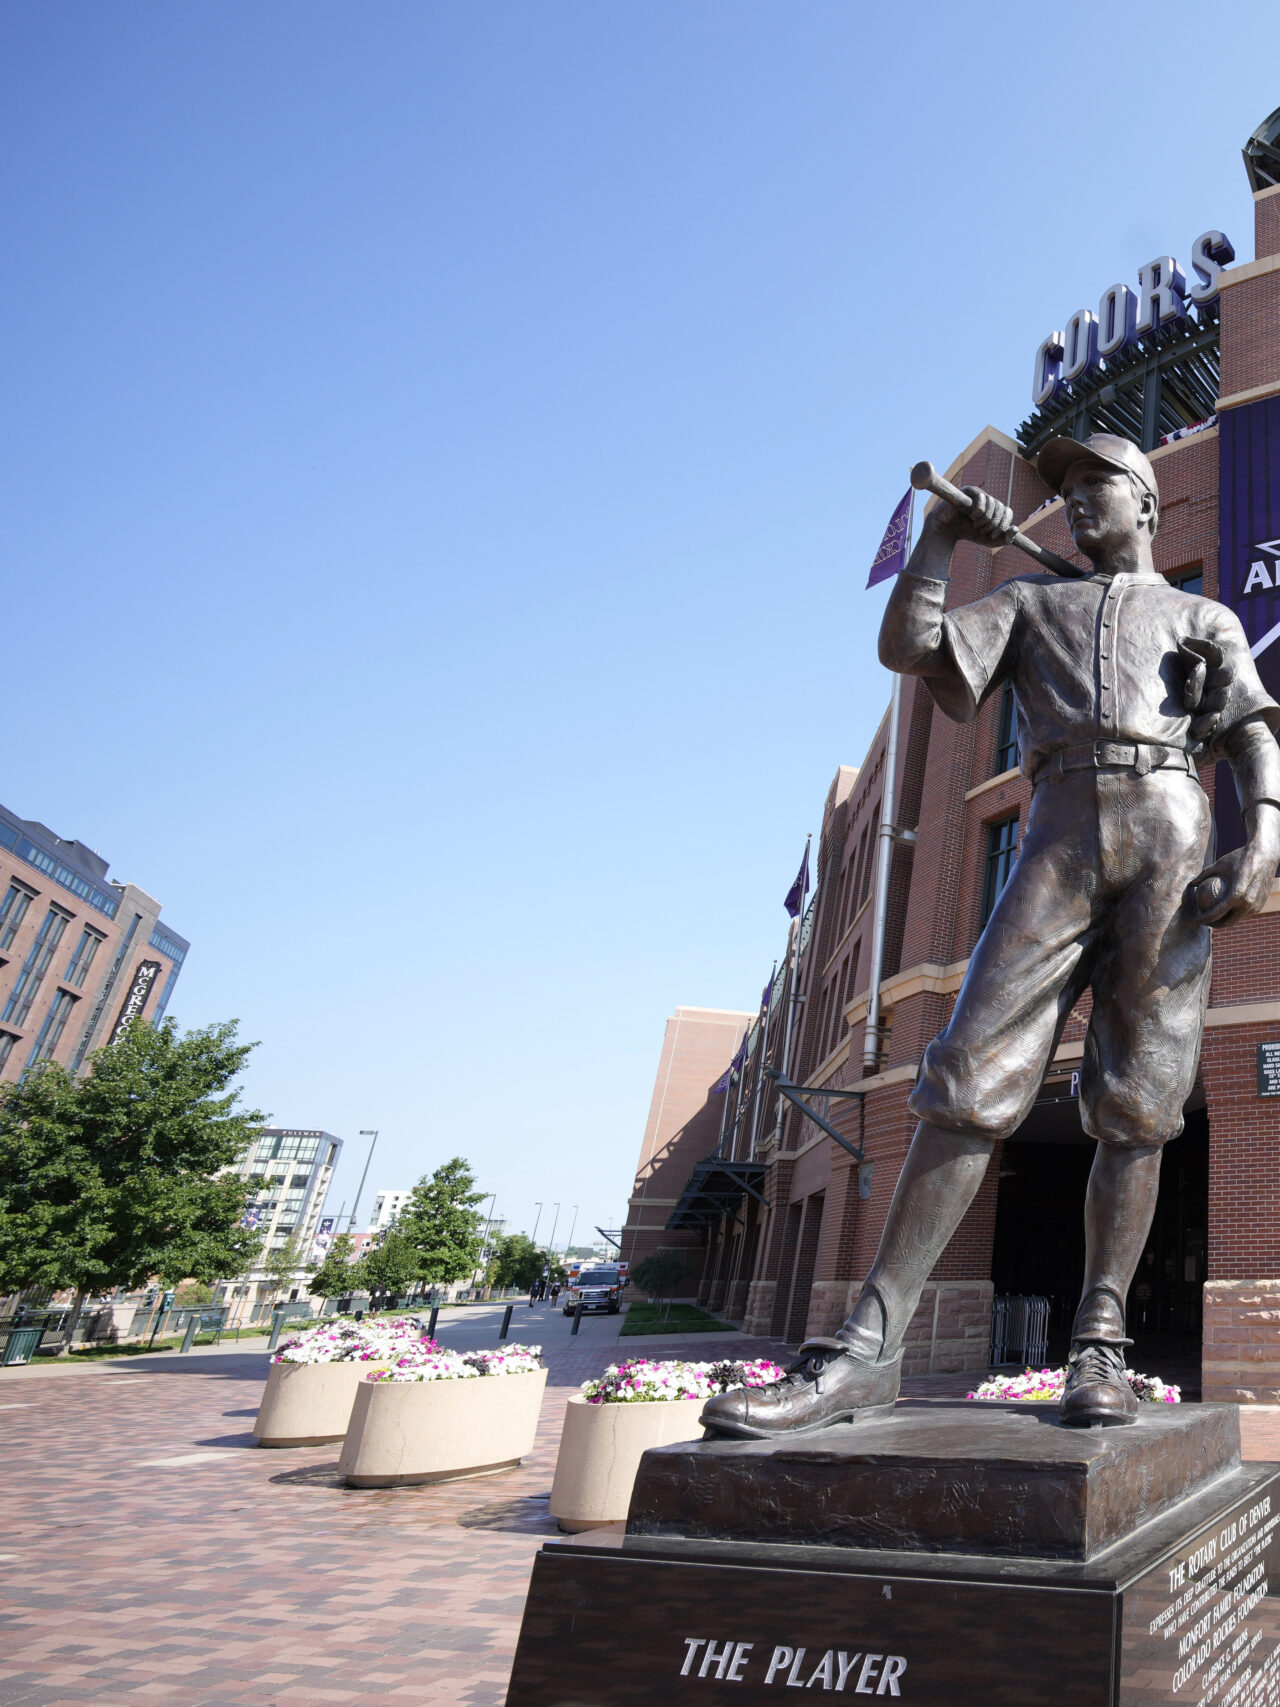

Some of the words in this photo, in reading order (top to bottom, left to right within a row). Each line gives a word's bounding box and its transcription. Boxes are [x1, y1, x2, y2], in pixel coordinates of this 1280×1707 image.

[1031, 230, 1235, 406] COORS
[1169, 1561, 1185, 1594] THE
[1188, 1536, 1218, 1578] ROTARY
[1220, 1522, 1237, 1551] CLUB
[1239, 1513, 1248, 1536] OF
[1250, 1496, 1271, 1528] DENVER
[1149, 1603, 1175, 1635] EXPRESSES
[1164, 1619, 1177, 1640] WHO
[1178, 1608, 1189, 1628] HAVE
[1172, 1638, 1211, 1694] COLORADO
[1212, 1611, 1236, 1651] ROCKIES
[1238, 1578, 1268, 1624] FOUNDATION
[1179, 1611, 1212, 1660] MONFORT
[1213, 1591, 1233, 1625] FAMILY
[1234, 1560, 1265, 1603] FOUNDATION
[679, 1637, 754, 1681] THE
[764, 1645, 908, 1697] PLAYER
